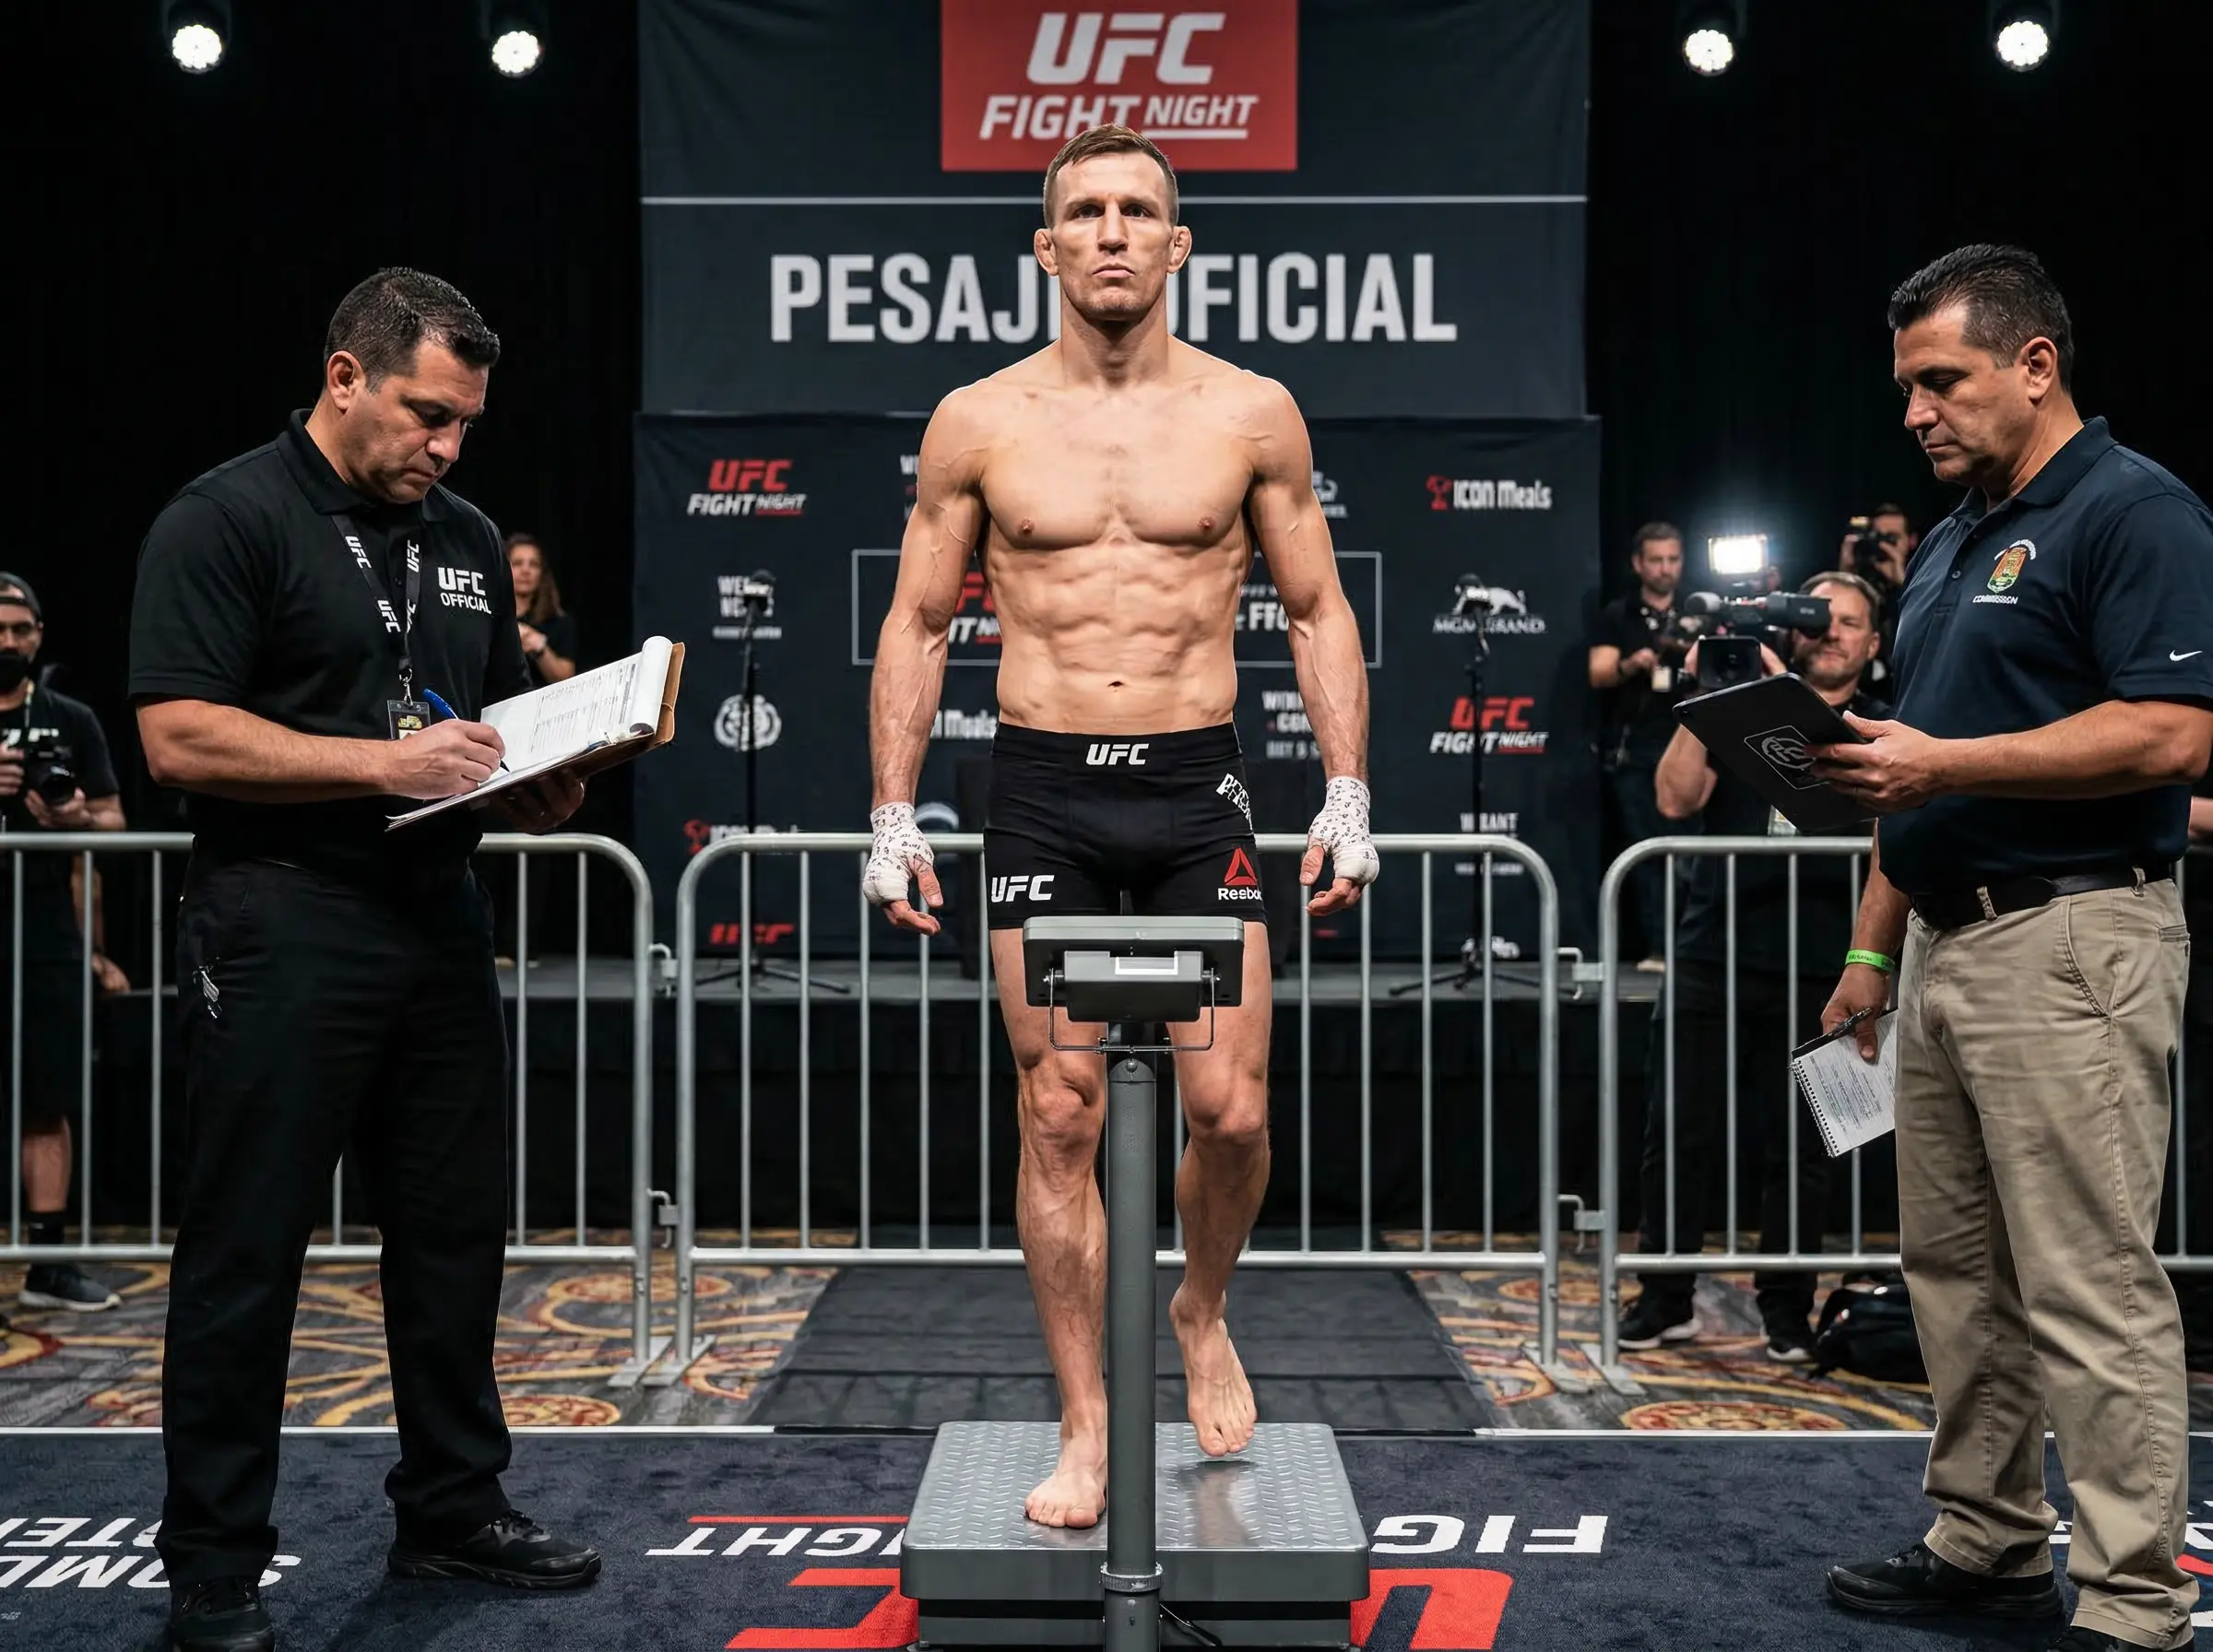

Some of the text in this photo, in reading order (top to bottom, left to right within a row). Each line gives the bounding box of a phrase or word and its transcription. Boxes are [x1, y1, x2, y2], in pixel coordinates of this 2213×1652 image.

[1026, 12, 1225, 85] UFC
[979, 95, 1260, 140] FIGHT NIGHT
[771, 253, 1060, 344] PESAJ
[708, 459, 793, 491] UFC
[686, 493, 756, 516] FIGHT
[345, 536, 373, 569] UFC
[407, 539, 420, 572] UFC
[437, 567, 486, 596] UFC
[377, 599, 402, 633] UFC
[440, 592, 492, 615] OFFICIAL
[1450, 697, 1534, 730] UFC
[1085, 744, 1150, 765] UFC
[991, 875, 1055, 903] UFC
[1370, 1515, 1609, 1554] FIG
